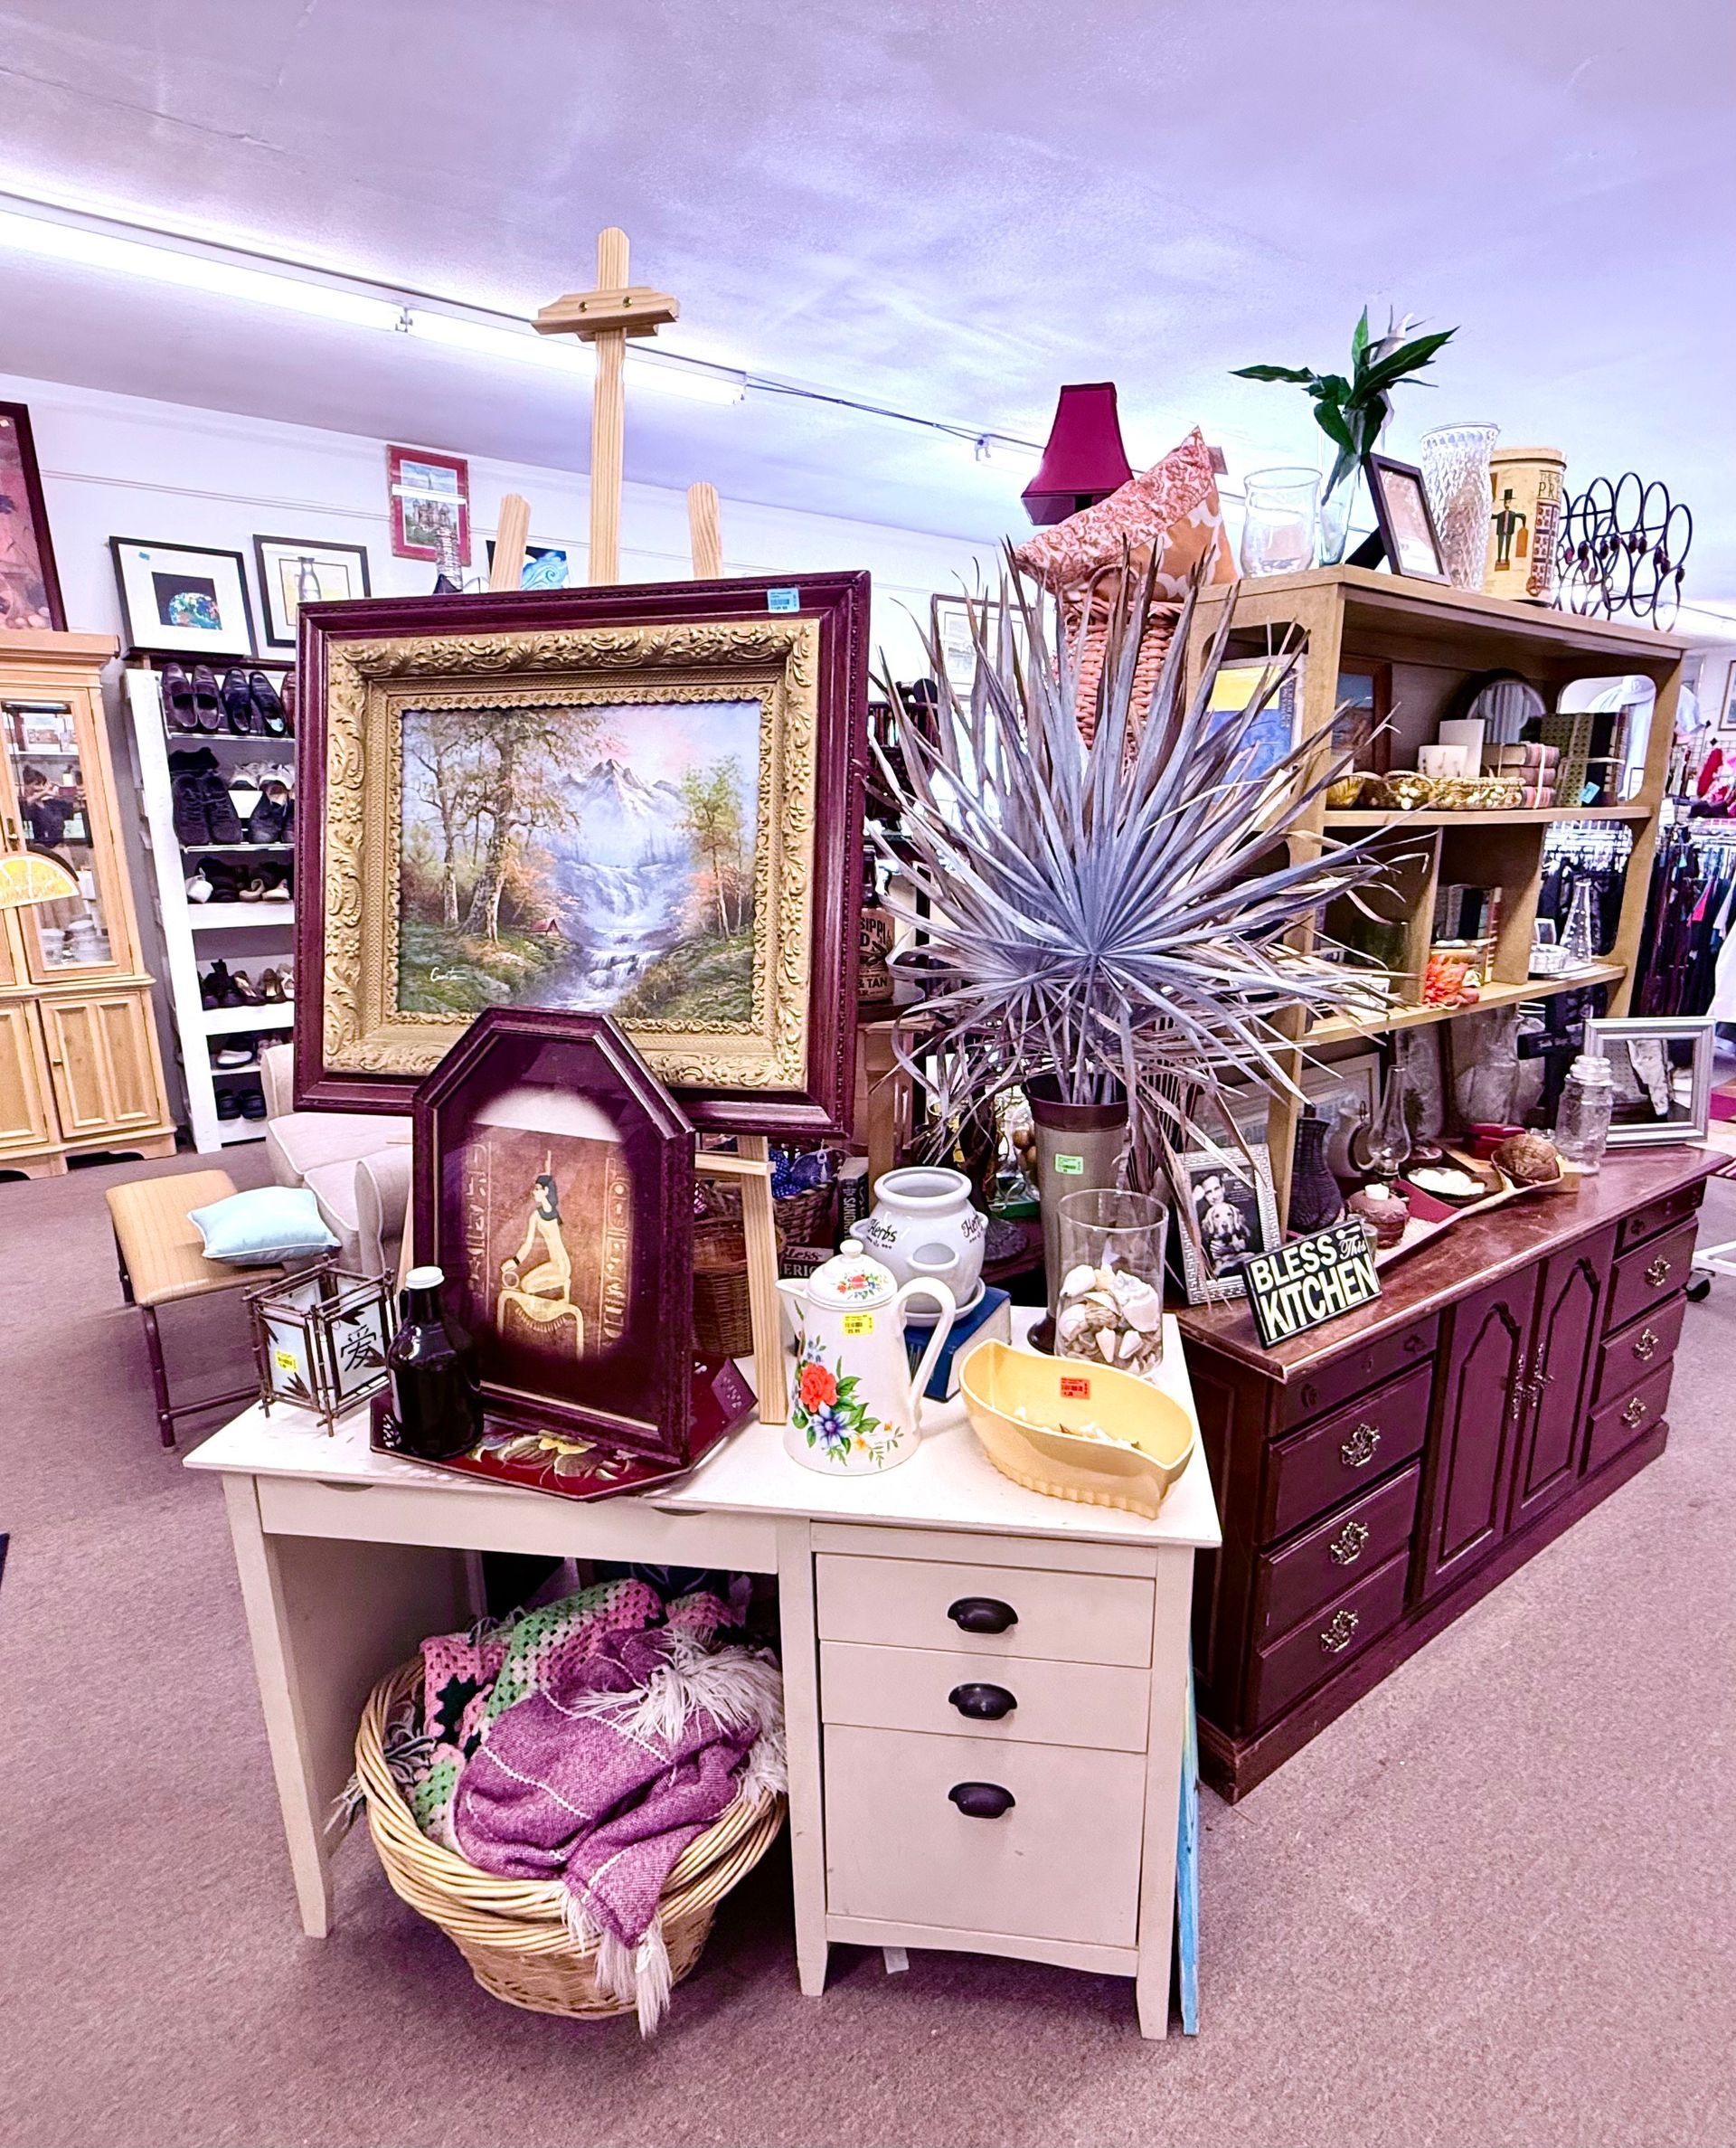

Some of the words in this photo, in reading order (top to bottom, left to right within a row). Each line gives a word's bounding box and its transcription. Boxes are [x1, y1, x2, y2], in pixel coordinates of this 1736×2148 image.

[867, 978, 888, 989] TAN
[868, 1218, 897, 1243] Herbs
[1250, 1235, 1337, 1293] BLESS
[1338, 1234, 1366, 1260] This
[1260, 1253, 1380, 1339] KITCHEN
